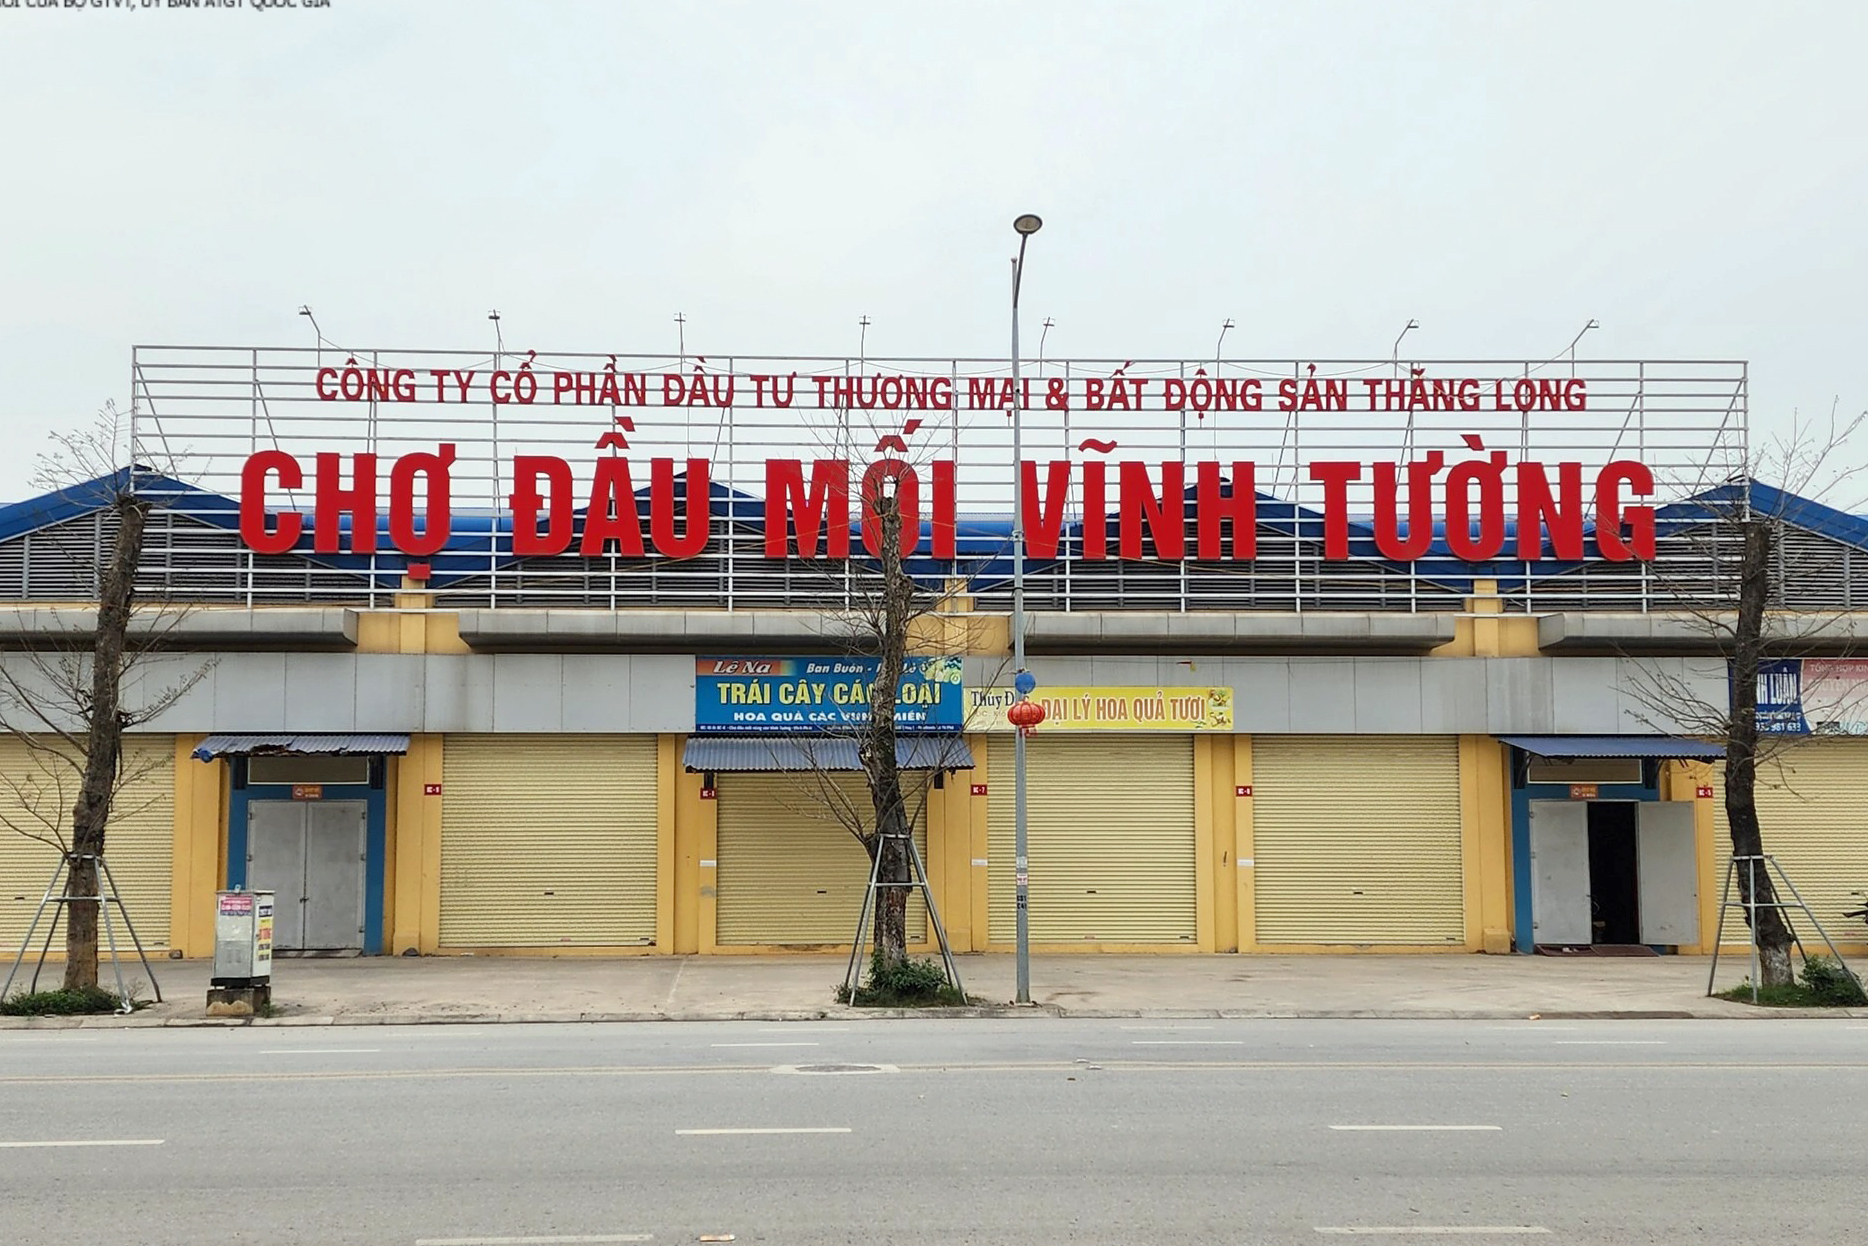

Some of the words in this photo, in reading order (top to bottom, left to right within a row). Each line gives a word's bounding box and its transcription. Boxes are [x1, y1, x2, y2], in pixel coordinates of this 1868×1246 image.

[316, 357, 416, 402] CÔNG
[430, 369, 477, 403] TY
[490, 349, 538, 405] CỔ
[554, 354, 647, 406] PHẦN
[661, 356, 735, 407] ĐẦU
[750, 371, 798, 408] TƯ
[812, 371, 953, 411] THƯƠNG
[1045, 377, 1070, 412] &
[1086, 361, 1149, 411] BẤT
[1163, 368, 1263, 419] ĐỘNG
[1278, 363, 1348, 411] SẢN
[1363, 367, 1480, 412] THĂNG
[1495, 378, 1587, 412] LONG
[240, 443, 457, 580] CHỢ
[509, 416, 710, 558] ĐẦU
[765, 418, 956, 560] MỐI
[1020, 438, 1257, 562] VĨNH
[1309, 433, 1657, 562] TƯỜNG
[741, 659, 773, 674] Na
[717, 678, 770, 705] TRÁI
[779, 678, 825, 705] CÂY
[970, 690, 1002, 710] Thúy
[734, 712, 766, 722] HOA
[1073, 694, 1090, 721] LÝ
[1096, 698, 1129, 721] HOA
[1133, 691, 1166, 723] QUẢ
[1170, 697, 1206, 721] TƯƠI
